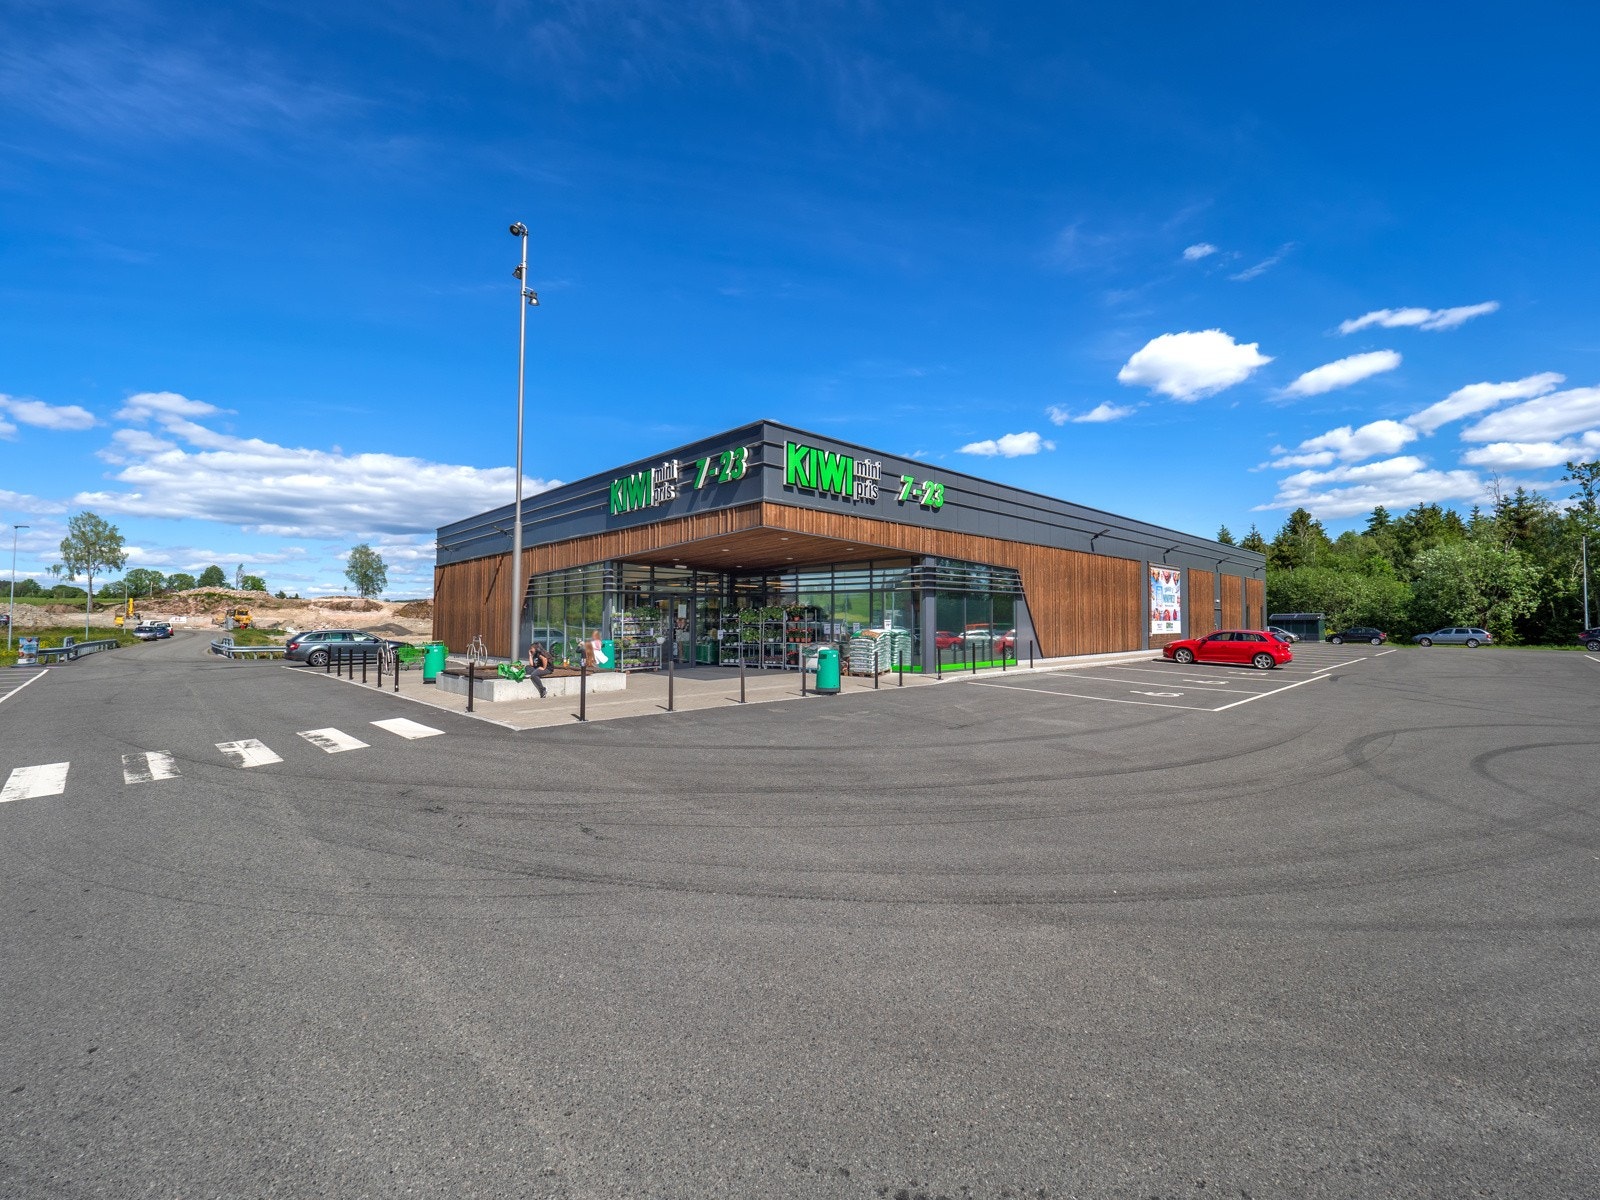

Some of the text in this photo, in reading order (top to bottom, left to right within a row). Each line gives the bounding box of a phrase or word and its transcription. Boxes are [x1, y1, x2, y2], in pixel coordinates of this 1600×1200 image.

[654, 460, 677, 482] mini
[783, 440, 854, 498] KIWI
[855, 458, 881, 480] mini
[609, 468, 654, 516] KIWI
[654, 481, 676, 506] pris
[854, 480, 880, 500] pris
